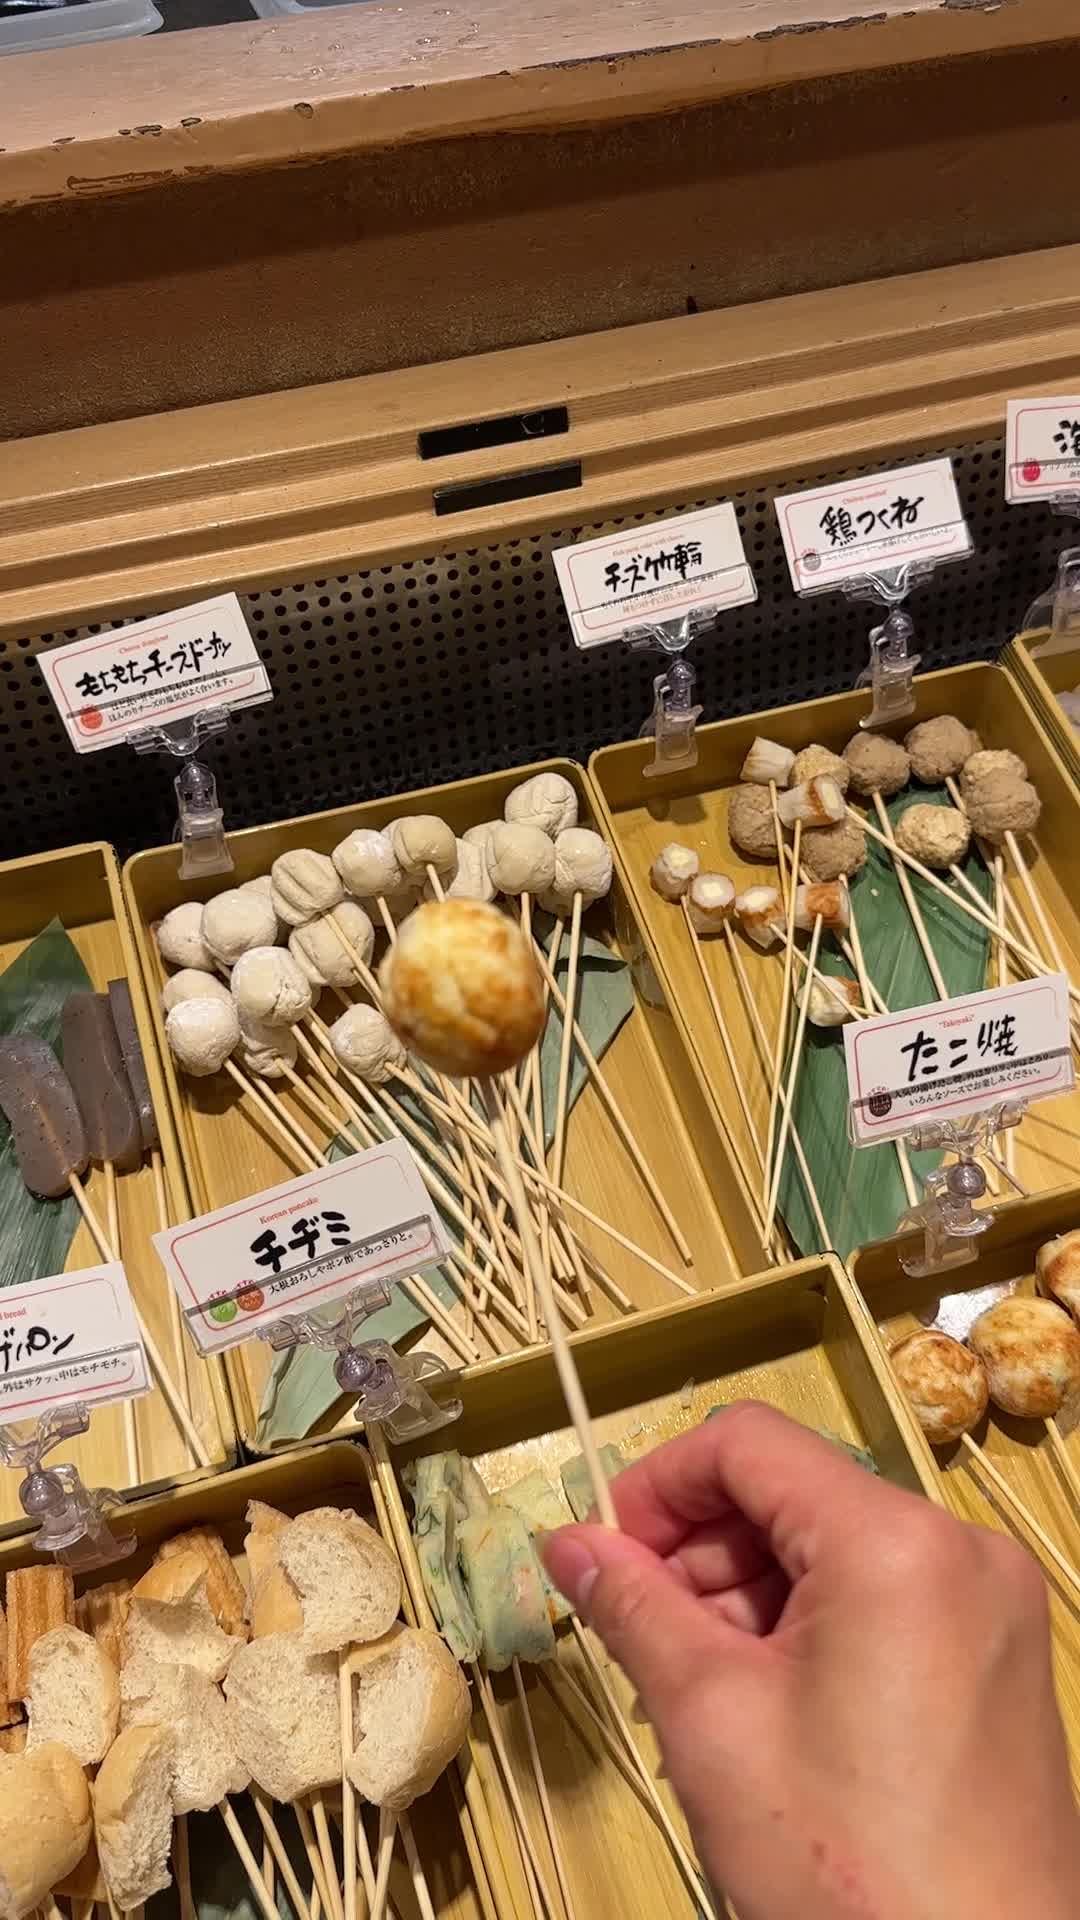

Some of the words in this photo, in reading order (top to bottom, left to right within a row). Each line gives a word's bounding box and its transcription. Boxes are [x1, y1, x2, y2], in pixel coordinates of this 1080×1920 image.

[819, 495, 925, 547] 鶏つくね
[604, 541, 702, 593] チーズ竹輪
[74, 631, 232, 698] もちもちチーズドーナツ
[900, 1014, 1019, 1082] たこ焼
[259, 1208, 288, 1225] Korean
